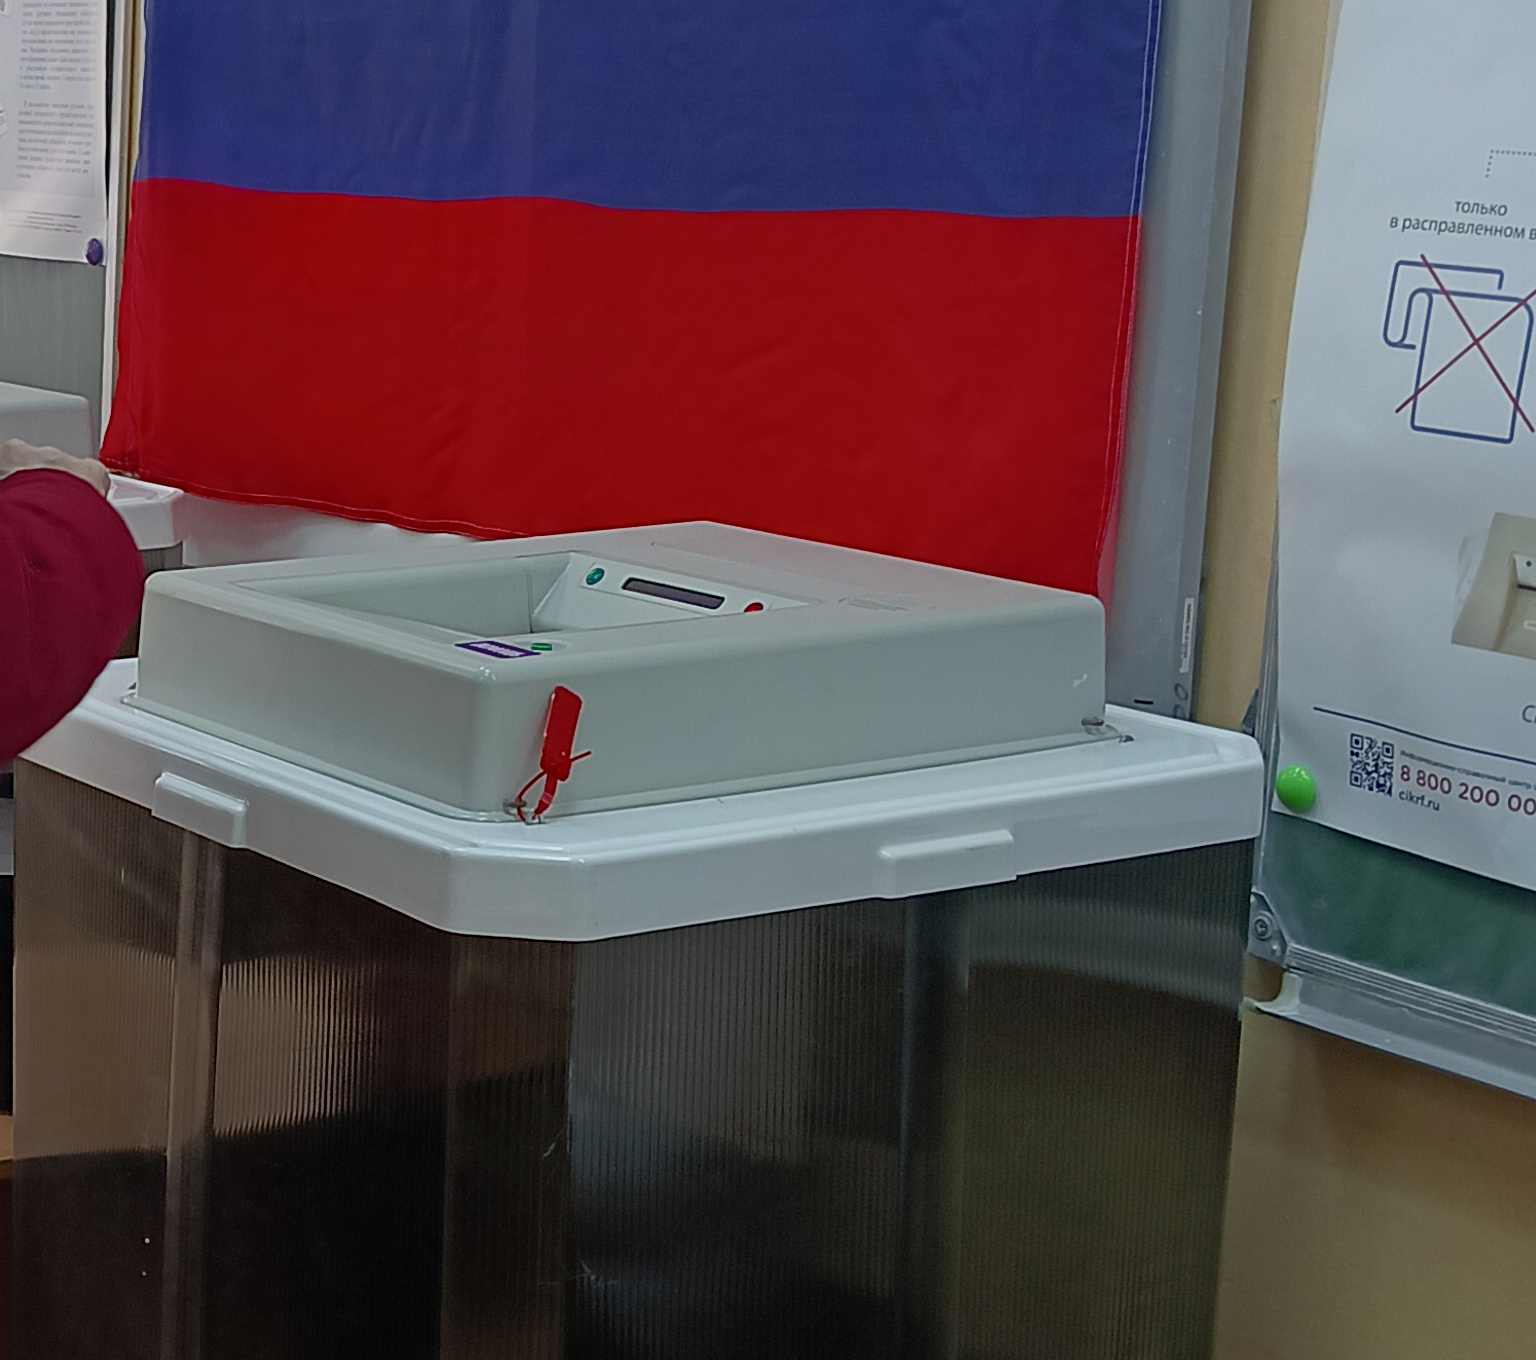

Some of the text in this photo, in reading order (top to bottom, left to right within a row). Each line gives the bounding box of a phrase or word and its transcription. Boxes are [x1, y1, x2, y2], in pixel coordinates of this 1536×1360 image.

[1455, 201, 1508, 216] только
[1389, 216, 1398, 228] в
[1401, 217, 1525, 239] расправленном
[1400, 764, 1411, 782] 8
[1416, 769, 1452, 795] 800
[1458, 782, 1500, 807] 200
[1398, 789, 1440, 812] cikrf.ru
